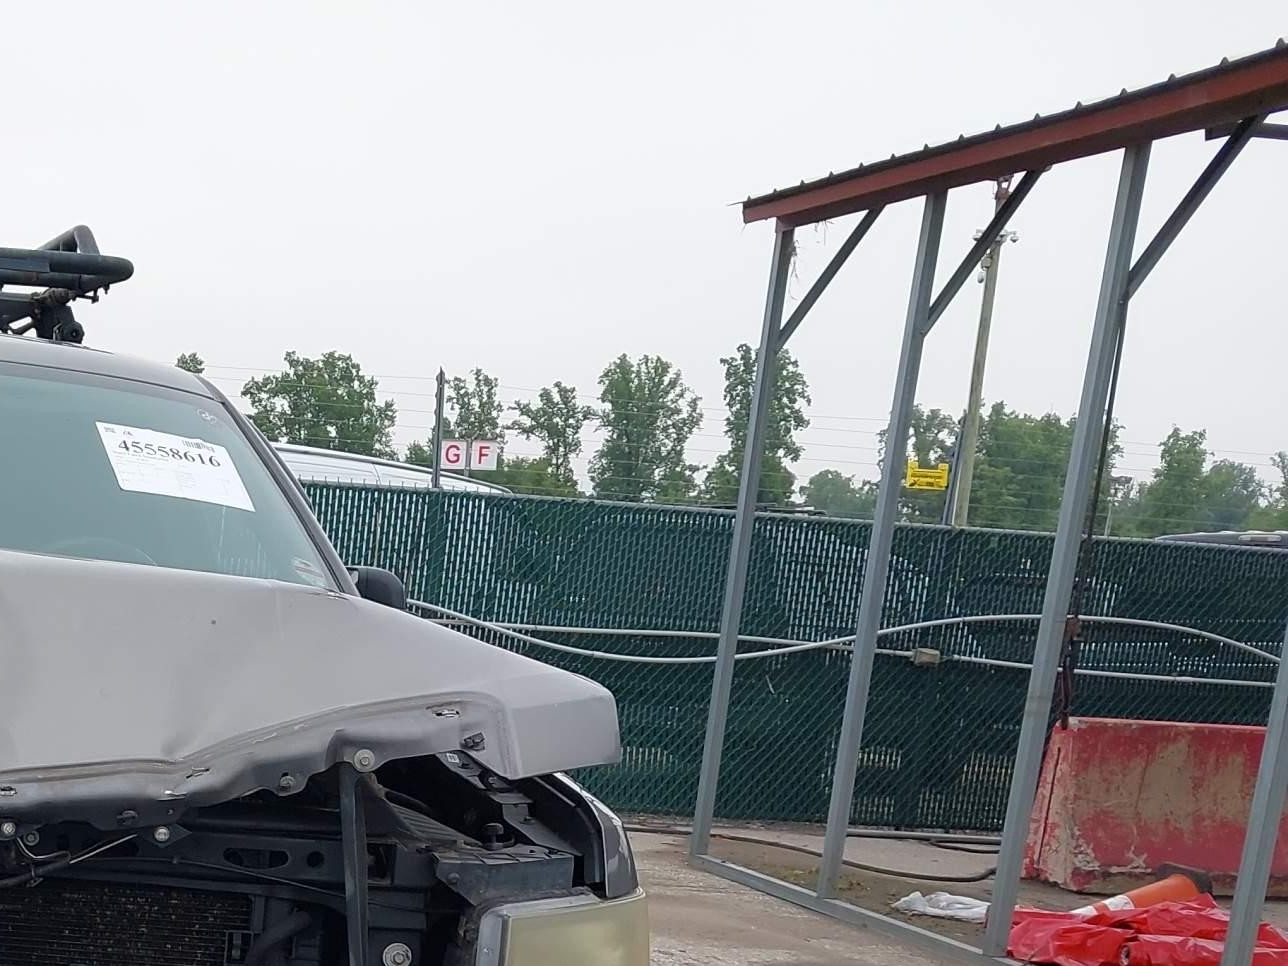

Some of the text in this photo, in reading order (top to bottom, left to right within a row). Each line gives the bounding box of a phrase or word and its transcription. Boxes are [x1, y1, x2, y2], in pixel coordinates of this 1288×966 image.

[118, 439, 222, 468] 45558616
[445, 444, 461, 464] G
[478, 445, 491, 465] F
